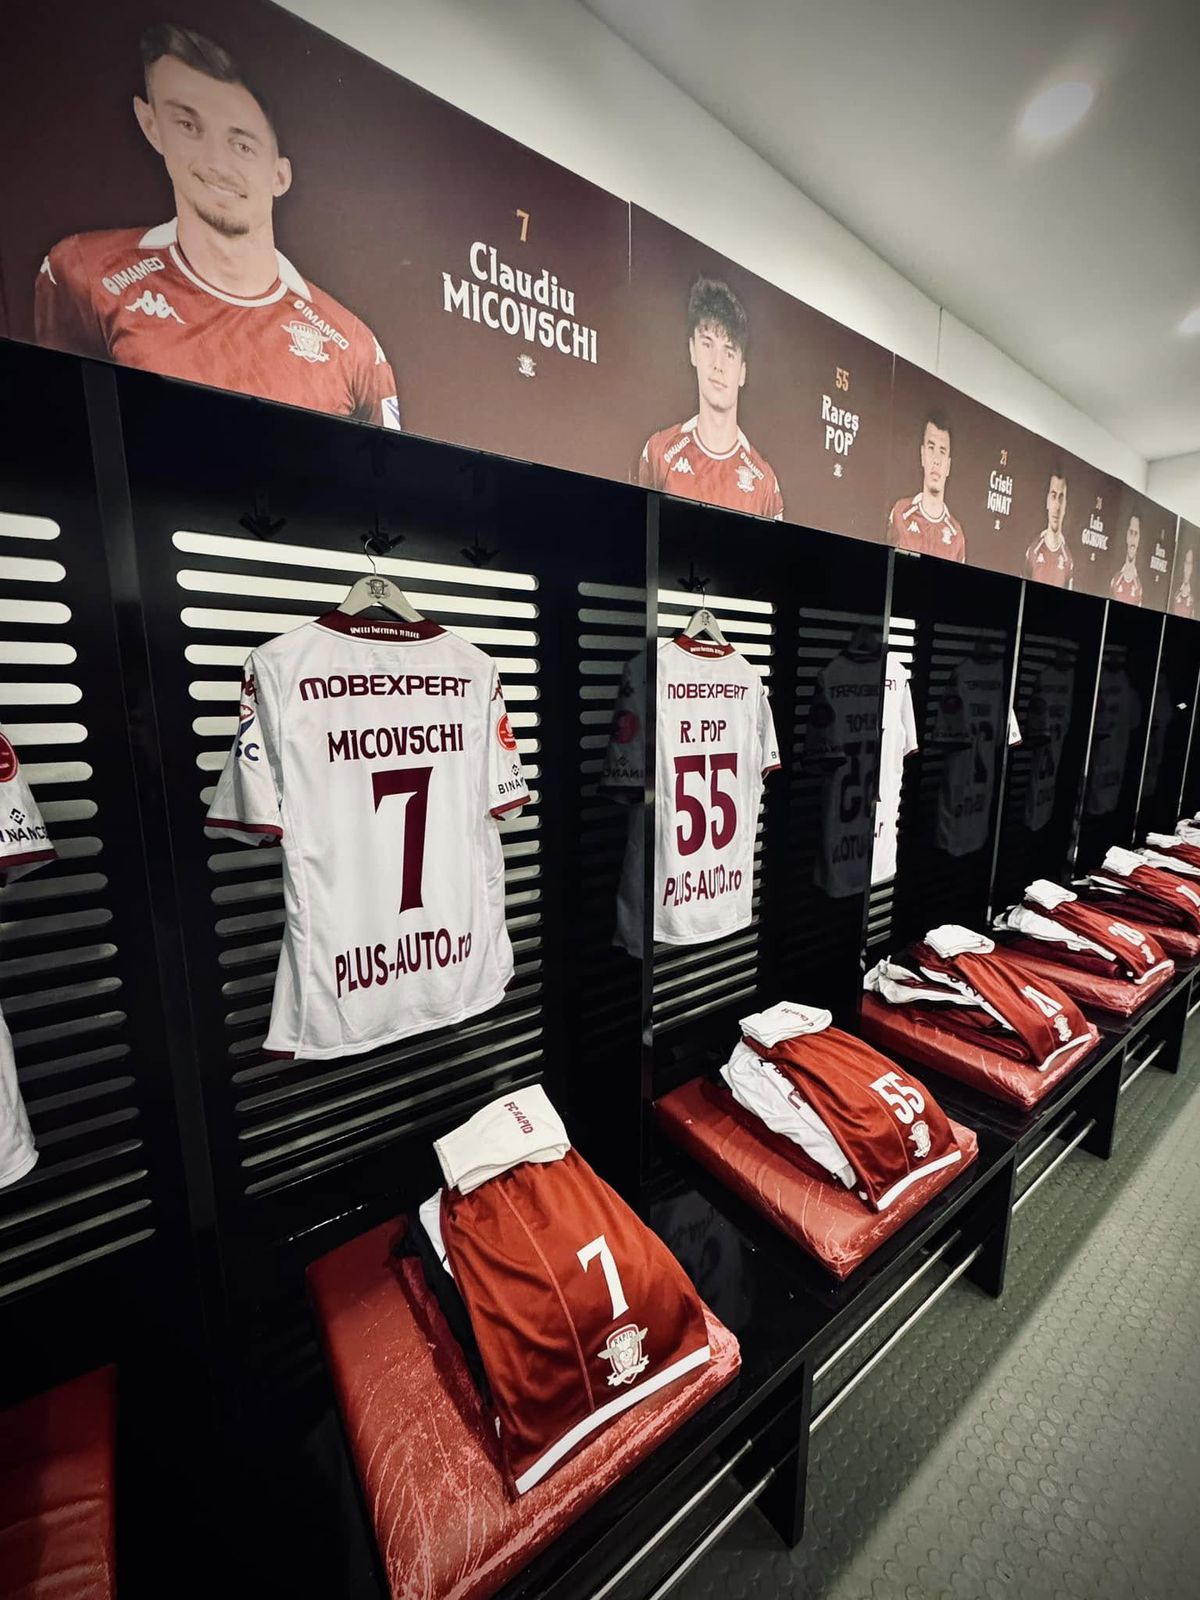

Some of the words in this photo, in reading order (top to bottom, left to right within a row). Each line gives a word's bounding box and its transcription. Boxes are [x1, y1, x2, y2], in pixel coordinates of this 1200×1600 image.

[516, 209, 530, 242] 7
[469, 241, 575, 316] Claudiu
[442, 271, 598, 364] MICOVSCHI
[835, 367, 849, 391] 55
[825, 424, 854, 456] POP
[989, 470, 1013, 495] Cristi
[987, 490, 1012, 515] IGNAT
[299, 674, 472, 702] MOBEXPERT
[327, 723, 464, 762] MICOVSCHI
[680, 720, 696, 743] R.
[701, 720, 727, 742] POP
[674, 752, 738, 856] 55
[372, 766, 434, 914] 7
[335, 927, 472, 998] PLUS-AUTO.ro
[869, 1071, 925, 1125] 55
[576, 1234, 630, 1320] 7
